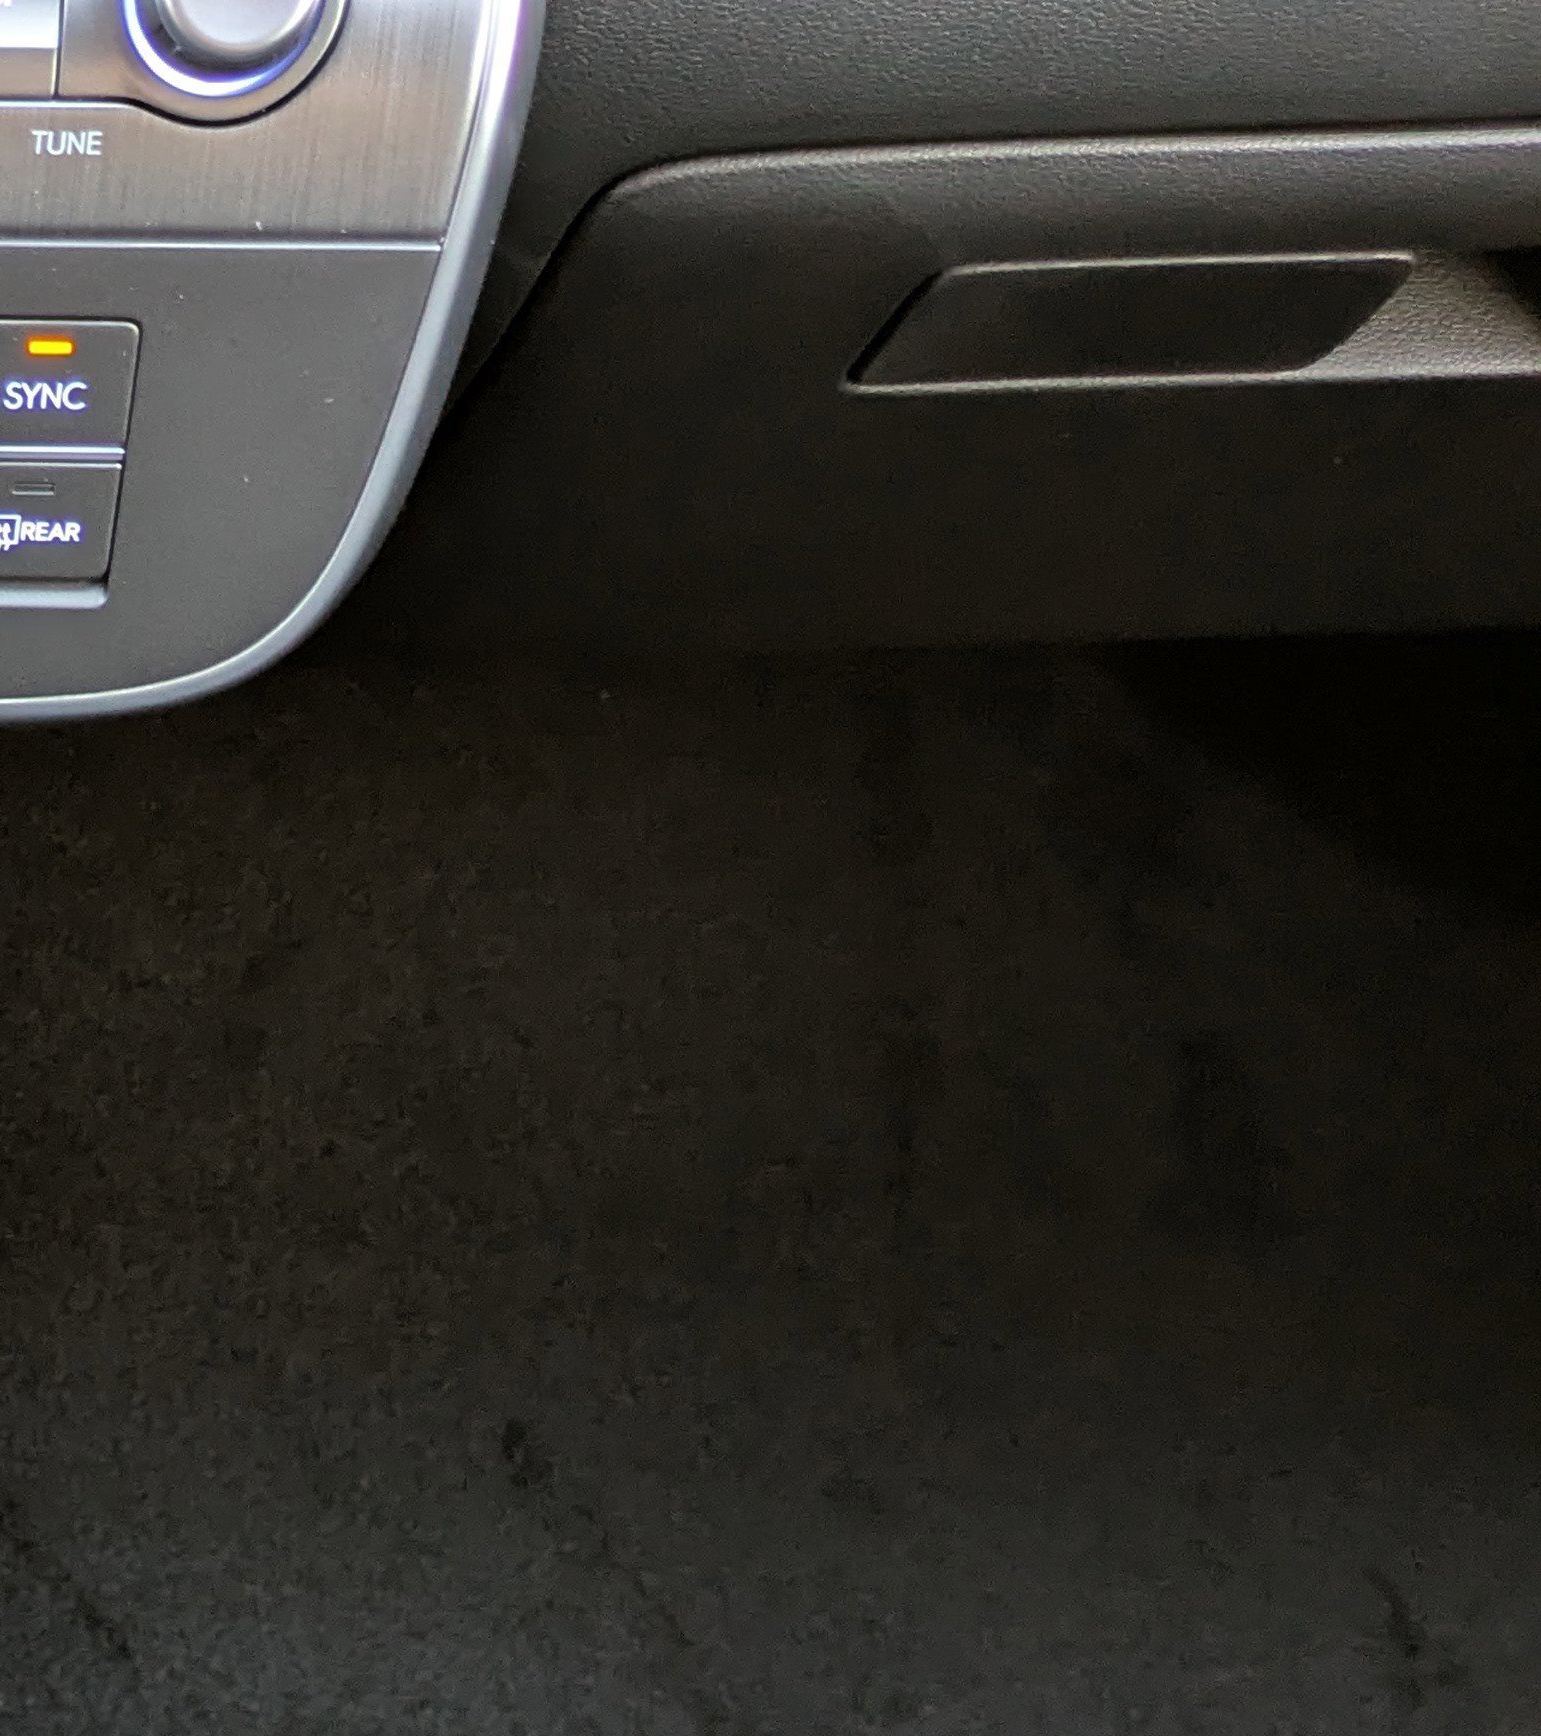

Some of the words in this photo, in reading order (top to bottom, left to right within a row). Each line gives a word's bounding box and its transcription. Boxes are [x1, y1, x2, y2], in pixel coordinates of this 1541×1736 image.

[30, 131, 103, 155] TUNE
[3, 382, 87, 410] SYNC
[20, 523, 80, 542] REAR
